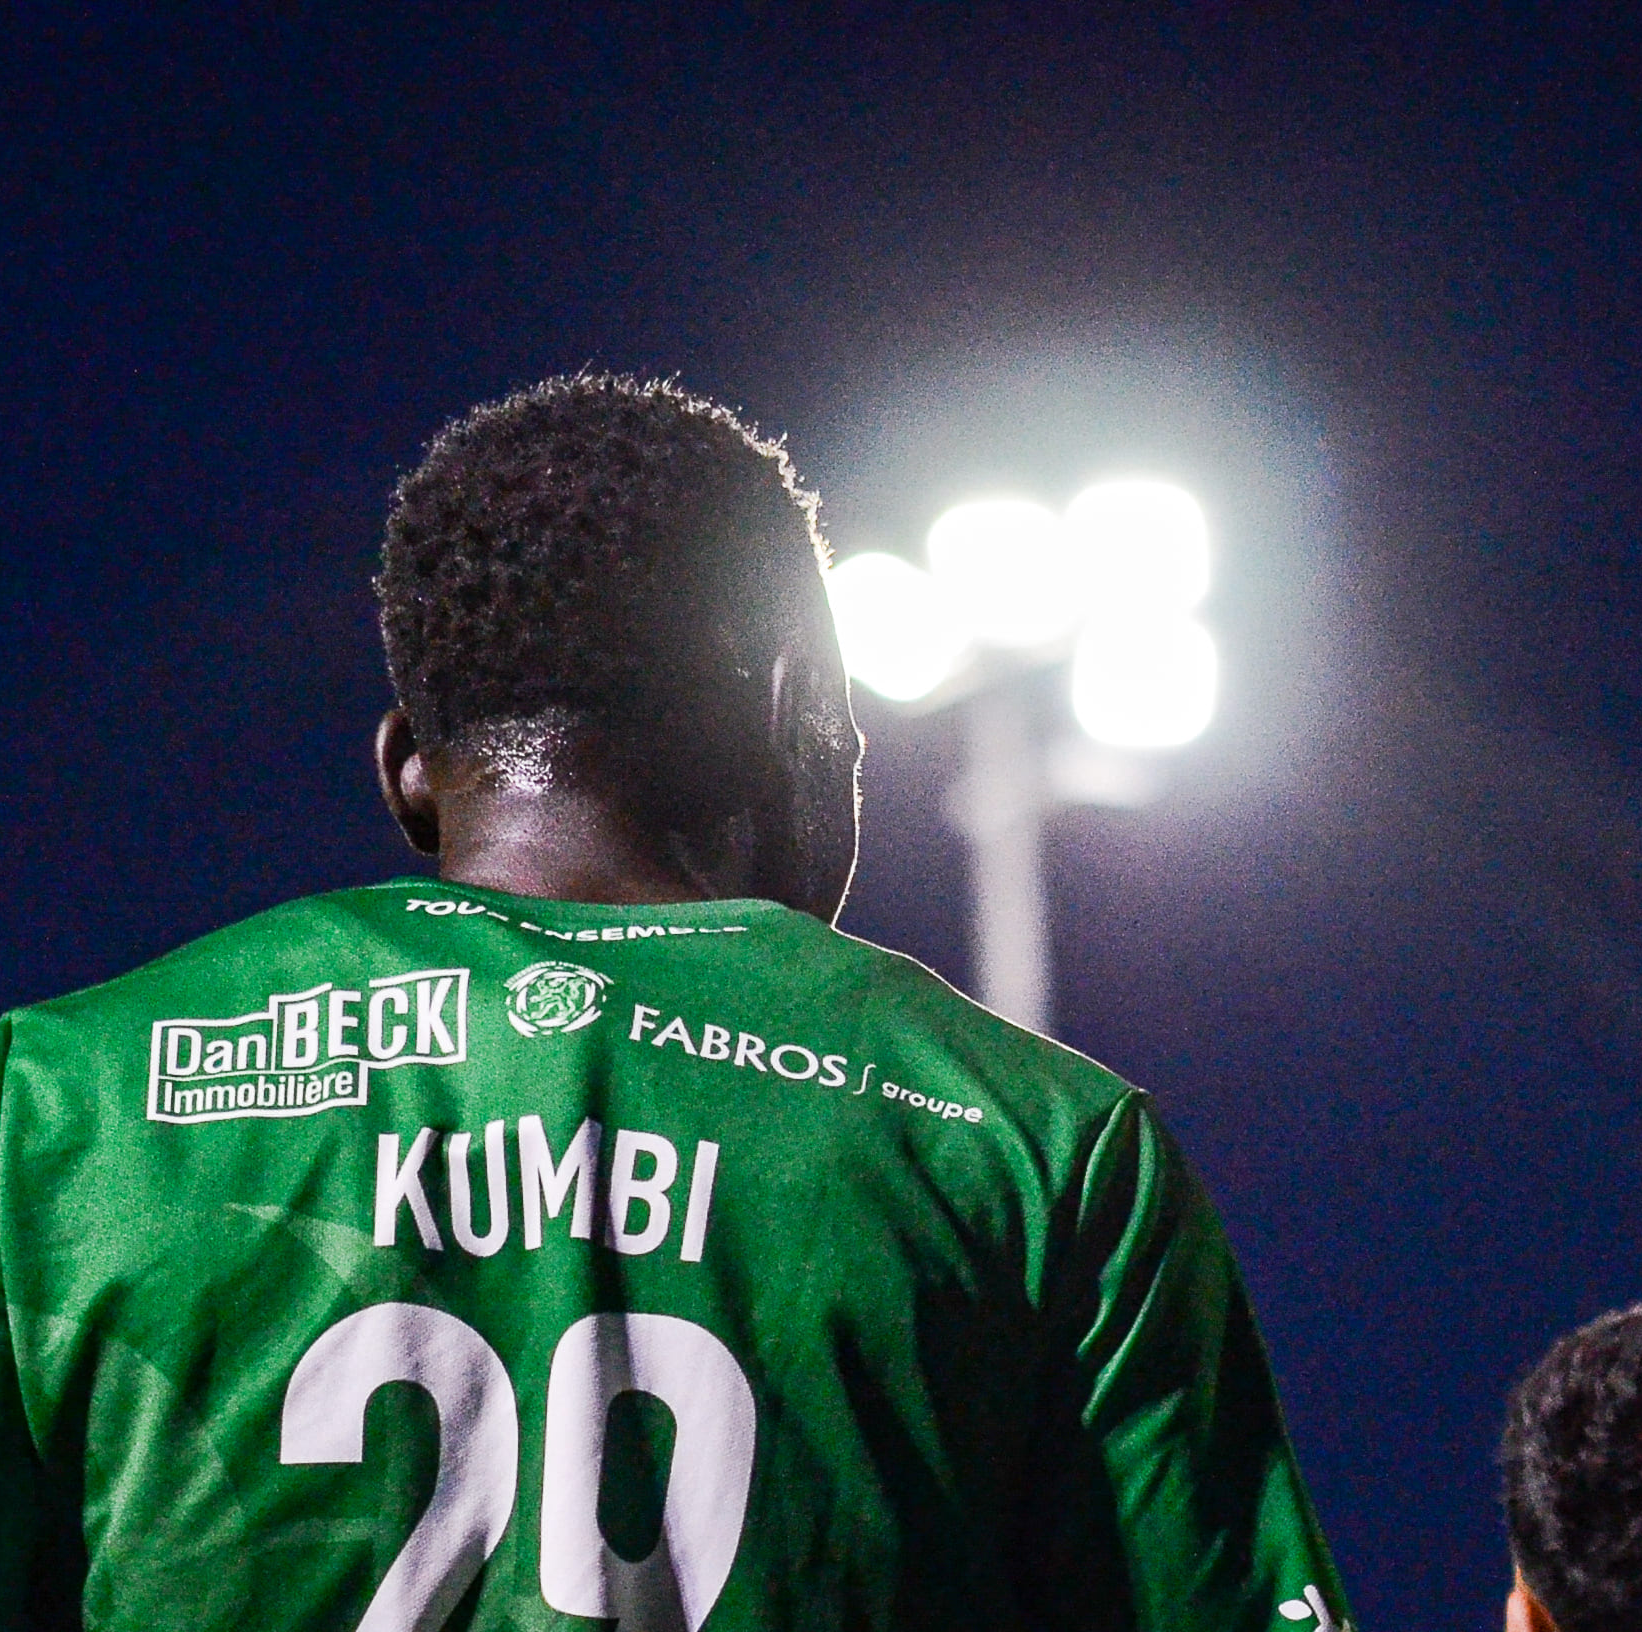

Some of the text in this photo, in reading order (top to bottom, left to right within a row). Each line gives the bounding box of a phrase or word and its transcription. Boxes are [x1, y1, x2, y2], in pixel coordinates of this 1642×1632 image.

[406, 899, 508, 921] TOU
[162, 1067, 356, 1116] Immobilière
[629, 1004, 984, 1123] FABROS groupe
[373, 1114, 720, 1263] KUMBI
